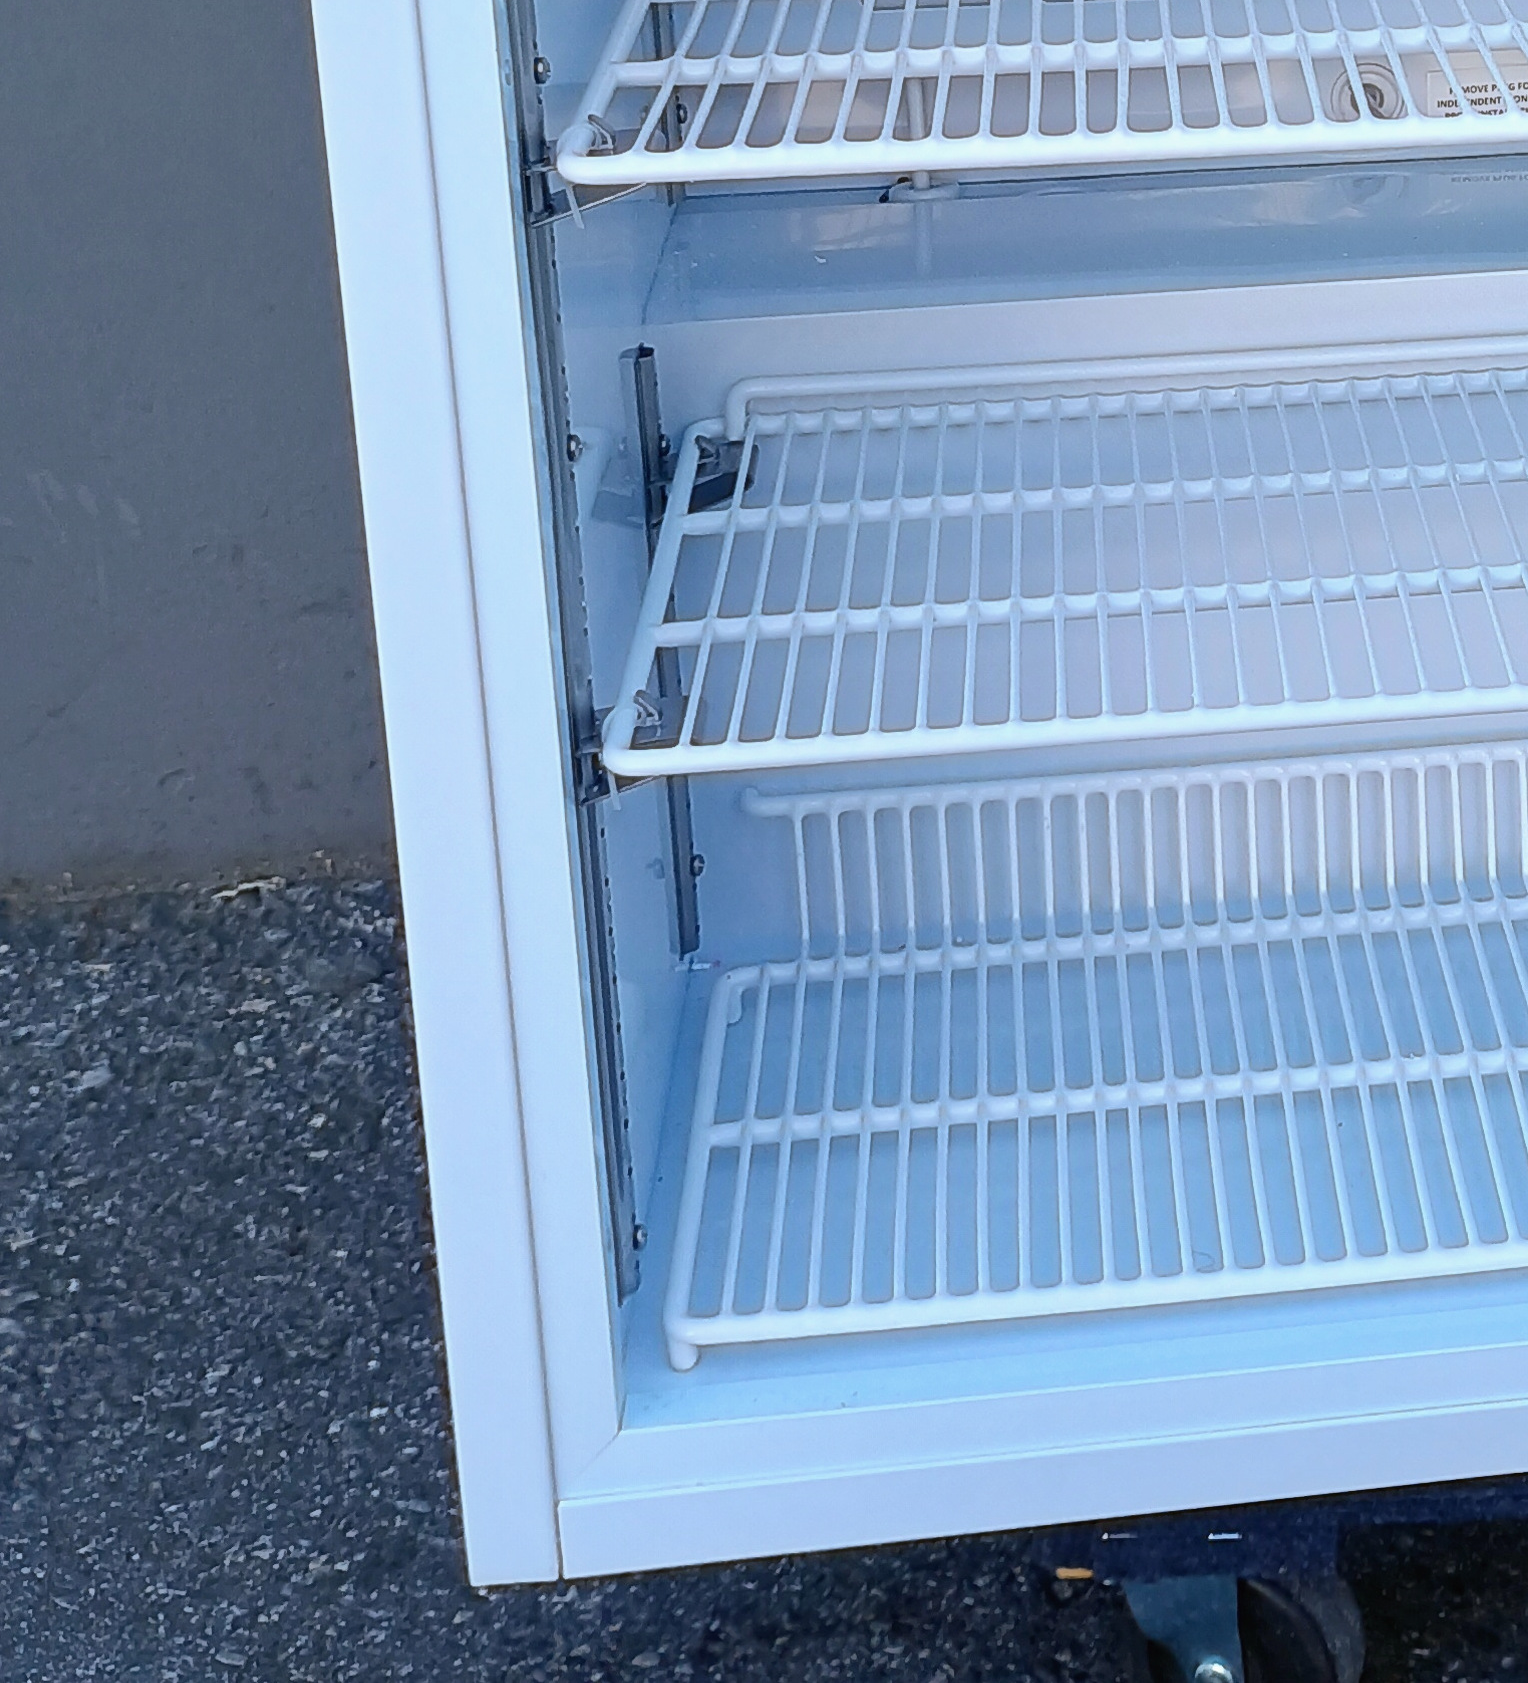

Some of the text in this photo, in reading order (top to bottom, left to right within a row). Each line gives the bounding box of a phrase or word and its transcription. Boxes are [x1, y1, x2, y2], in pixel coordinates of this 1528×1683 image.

[1450, 84, 1489, 95] MOVE
[1492, 82, 1515, 92] PG
[1437, 96, 1502, 108] INDENDENT
